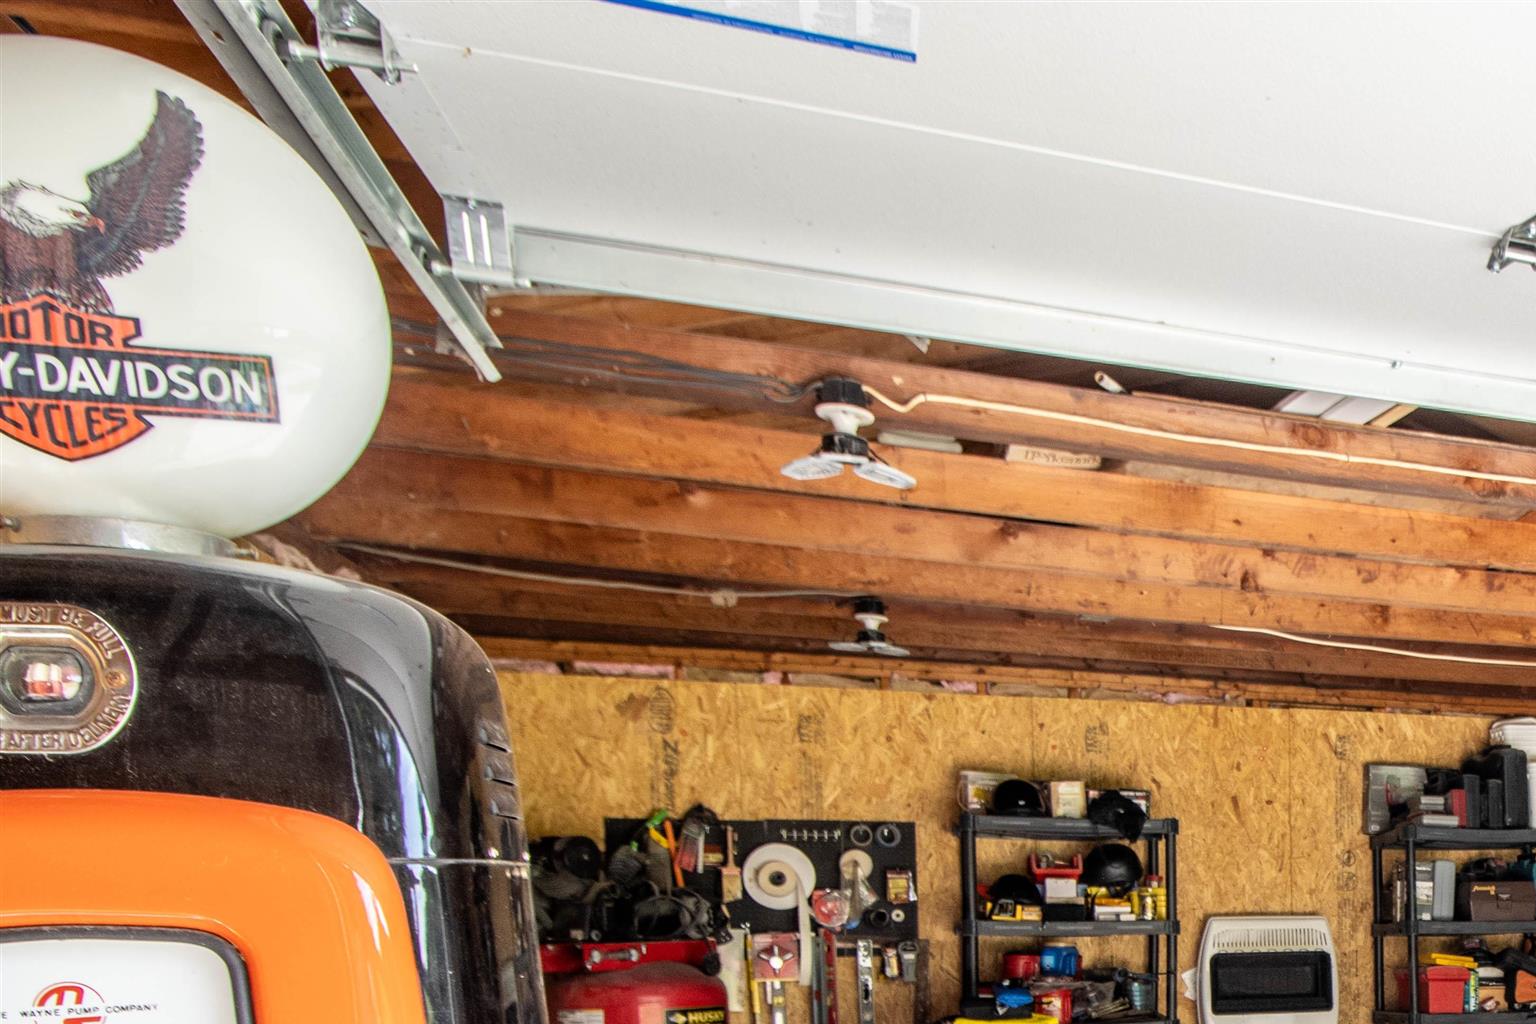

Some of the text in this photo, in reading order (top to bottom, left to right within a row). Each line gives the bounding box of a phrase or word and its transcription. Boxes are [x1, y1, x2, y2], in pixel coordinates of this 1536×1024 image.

[0, 300, 113, 347] OTOR
[20, 1003, 158, 1017] WAYNE PUMP COMPANY
